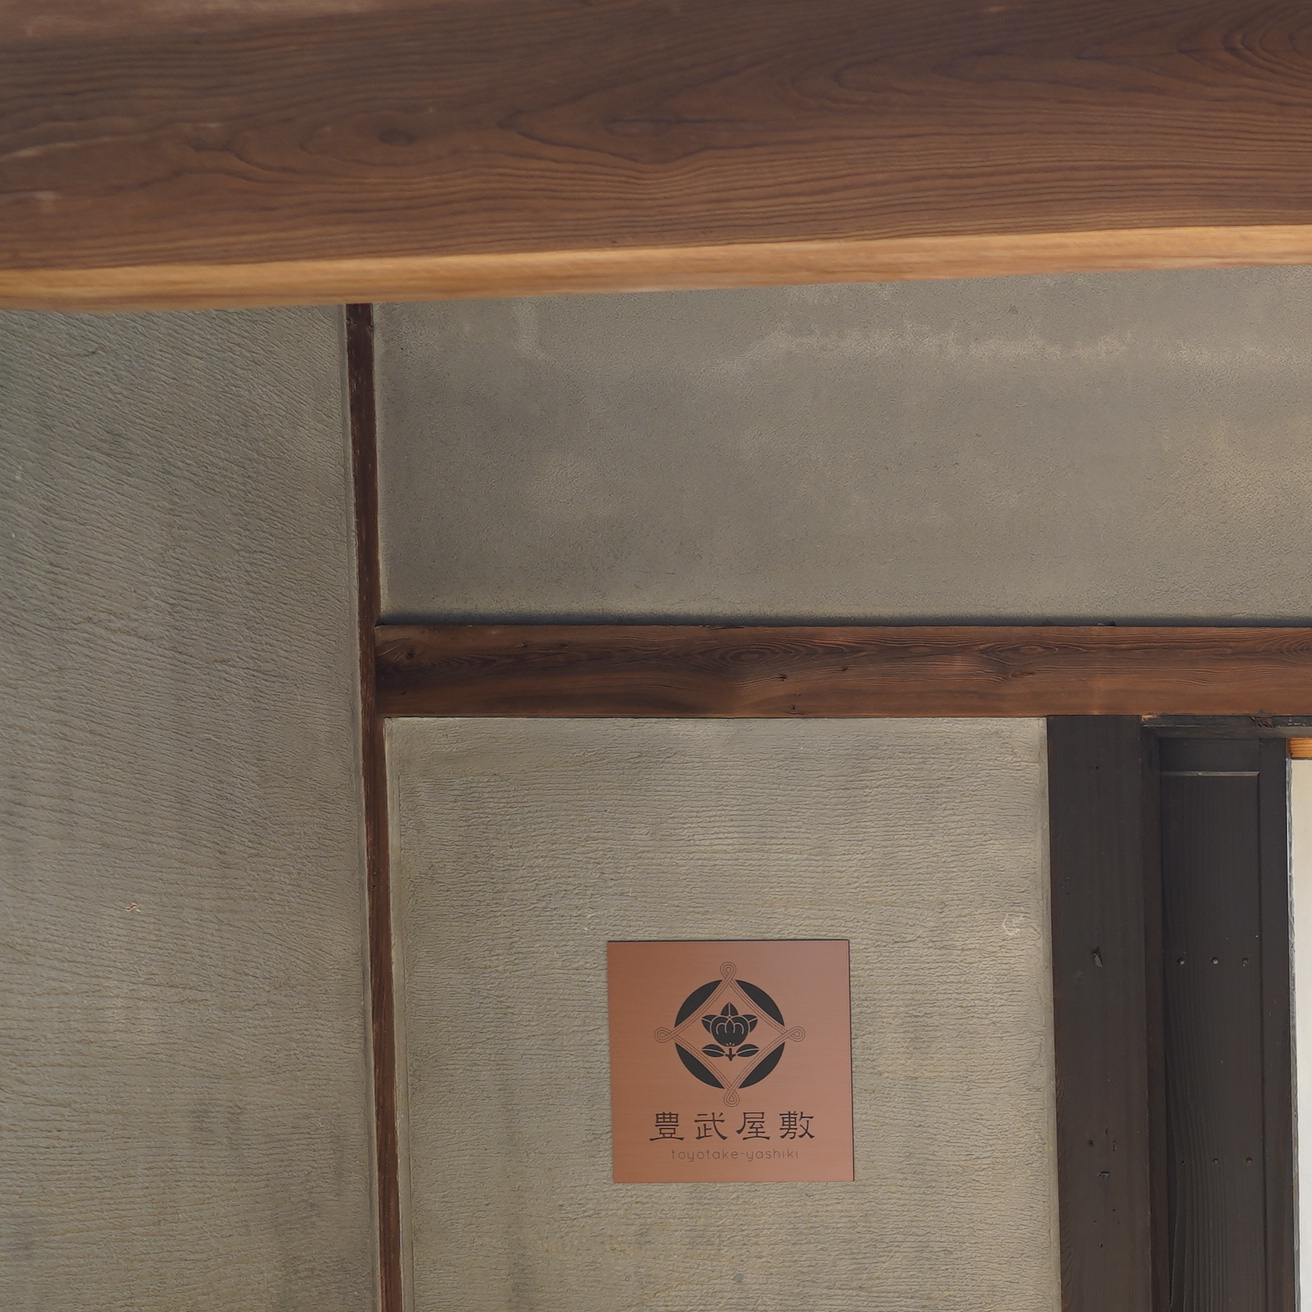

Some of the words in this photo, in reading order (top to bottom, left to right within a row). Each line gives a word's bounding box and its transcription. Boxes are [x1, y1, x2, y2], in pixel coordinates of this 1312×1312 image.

[649, 1110, 816, 1141] 豊武屋敷
[671, 1148, 799, 1163] toyotake-yashiki
